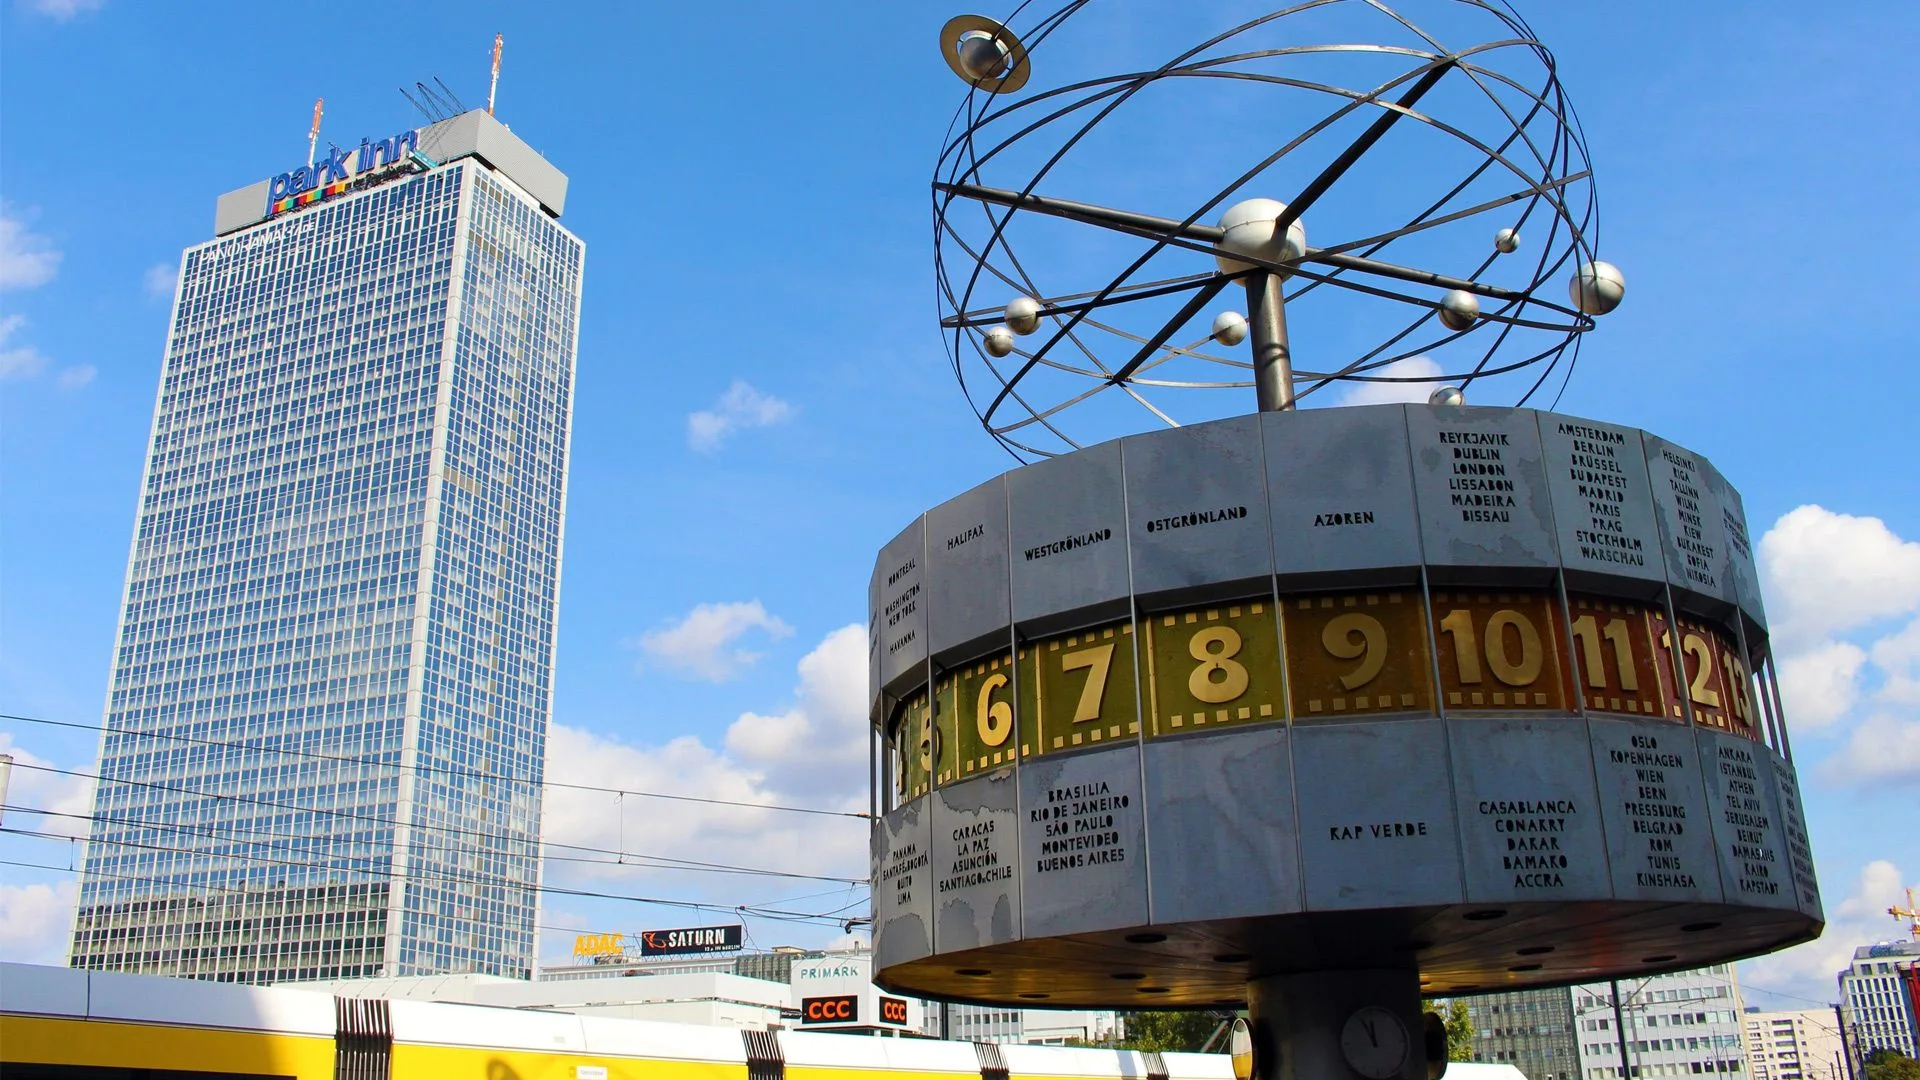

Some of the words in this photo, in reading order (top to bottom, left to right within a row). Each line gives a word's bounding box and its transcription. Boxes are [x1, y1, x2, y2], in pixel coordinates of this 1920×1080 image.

[267, 147, 350, 217] park
[356, 129, 419, 174] inn
[1439, 432, 1510, 446] REYKJAVIK
[1558, 423, 1625, 445] AMSTERDAM
[1453, 448, 1500, 460] DUBLIN
[1573, 439, 1614, 458] BERLIN
[1453, 463, 1505, 476] LONDON
[1571, 454, 1622, 473] BRÜSSEL
[1662, 449, 1696, 472] HELSINKI
[1570, 468, 1627, 489] BUDAPEST
[1672, 467, 1691, 483] RIGA
[1449, 478, 1514, 492] LISSABON
[1578, 485, 1624, 503] MADRID
[1669, 479, 1699, 500] TALLINN
[1452, 494, 1516, 508] MADEIRA
[1589, 501, 1621, 517] PARIS
[1675, 494, 1700, 513] WILNA
[1147, 506, 1247, 533] OSTGRÖNLAND
[1314, 511, 1374, 527] AZOREN
[1462, 510, 1510, 523] BISSAU
[1592, 517, 1622, 533] PRAG
[1678, 508, 1702, 528] MINSK
[947, 524, 984, 551] HALIFAX
[1576, 530, 1642, 551] STOCKHOLM
[1683, 525, 1701, 540] KIEW
[1024, 528, 1112, 561] WESTGRÖNLAND
[1677, 536, 1714, 559] BUKAREST
[1580, 546, 1644, 566] WARSCHAU
[1686, 554, 1709, 572] SOFIA
[888, 558, 916, 588] MONTREAL
[1685, 567, 1716, 588] NIKOSIA
[885, 582, 920, 617] WASHINGTON
[888, 613, 900, 628] NEW
[902, 600, 916, 619] YORK
[889, 629, 916, 656] HAVANNA
[1321, 612, 1388, 690] 9
[1440, 609, 1543, 686] 10
[1573, 615, 1638, 691] 11
[1188, 625, 1249, 704] 8
[1662, 628, 1720, 708] 12
[1062, 643, 1116, 723] 7
[1723, 650, 1753, 727] 13
[977, 673, 1012, 746] 6
[1631, 735, 1657, 750] OSLO
[1610, 750, 1683, 768] KOPENHAGEN
[1719, 747, 1752, 764] ANKARA
[1636, 769, 1664, 784] WIEN
[1720, 762, 1757, 781] ISTANBUL
[1048, 782, 1110, 803] BRASILIA
[1638, 786, 1667, 800] BERN
[1729, 779, 1754, 796] ATHEN
[1031, 809, 1049, 823] RIO
[1053, 804, 1068, 819] DE
[1072, 795, 1129, 816] JANEIRO
[1479, 800, 1576, 815] CASABLANCA
[1625, 802, 1686, 819] PRESSBURG
[1726, 795, 1741, 809] TEL
[1744, 798, 1761, 813] AVIV
[1045, 819, 1068, 837] SÃO
[1074, 814, 1113, 832] PAULO
[1495, 818, 1565, 833] CONAKRY
[1633, 820, 1684, 836] BELGRAD
[1724, 811, 1769, 830] JERUSALEM
[952, 820, 995, 841] CARACAS
[1330, 825, 1363, 841] KAP
[1370, 822, 1427, 838] VERDE
[1737, 828, 1763, 845] BEIRUT
[893, 843, 916, 861] PANAMA
[957, 843, 969, 856] LA
[973, 837, 989, 853] PAZ
[1042, 831, 1119, 855] MONTEVIDEO
[1507, 837, 1560, 851] DAKAR
[1649, 838, 1673, 852] ROM
[952, 850, 997, 874] ASUNCIÓN
[1037, 856, 1083, 873] BUENOS
[1088, 848, 1125, 865] AIRES
[1503, 854, 1568, 870] BAMAKO
[1647, 855, 1681, 870] TUNIS
[1744, 862, 1768, 878] KAIRO
[1514, 873, 1564, 888] ACCRA
[1636, 872, 1696, 889] KINSHASA
[1740, 879, 1779, 895] KAPSTADT
[898, 890, 911, 905] LIMA
[573, 932, 625, 957] ADAC
[668, 928, 725, 948] SATURN
[800, 965, 859, 980] PRIMARK
[808, 1000, 850, 1020] CCC
[883, 1003, 906, 1021] CCC
